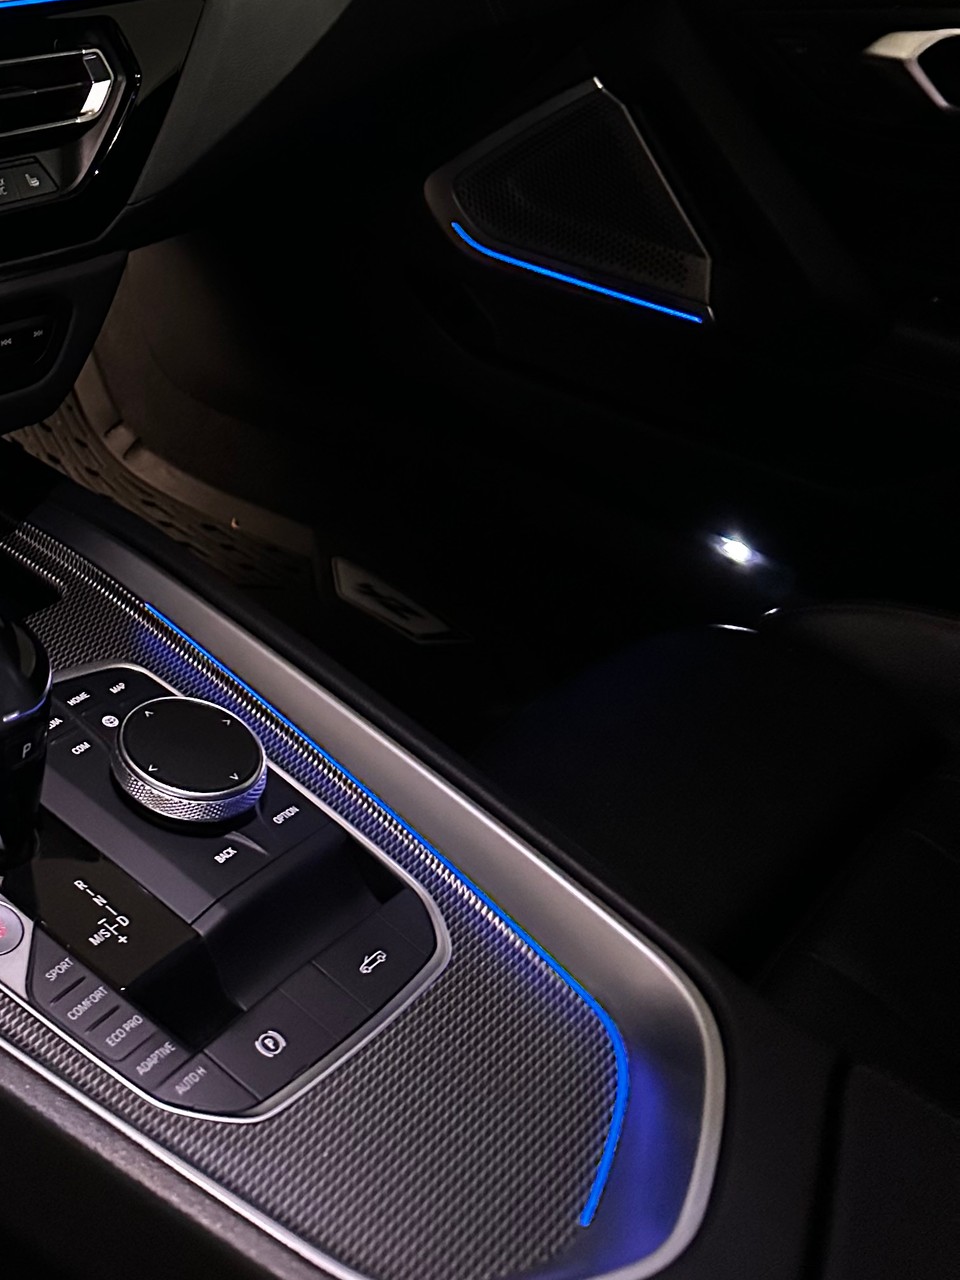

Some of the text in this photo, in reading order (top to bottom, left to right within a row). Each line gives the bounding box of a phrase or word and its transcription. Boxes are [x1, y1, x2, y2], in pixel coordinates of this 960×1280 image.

[109, 682, 126, 694] MAP
[66, 691, 91, 706] HOME
[22, 742, 32, 759] P
[71, 741, 91, 755] COM
[272, 805, 300, 825] OPTION
[213, 846, 238, 864] BACK
[73, 880, 88, 890] R
[92, 894, 108, 907] N
[115, 915, 130, 927] D
[44, 957, 74, 981] SPORT
[66, 986, 108, 1021] COMFORT
[105, 1014, 144, 1047] ECO PRO
[135, 1041, 176, 1076] ADAPTIVE
[174, 1065, 208, 1096] AUTO H
